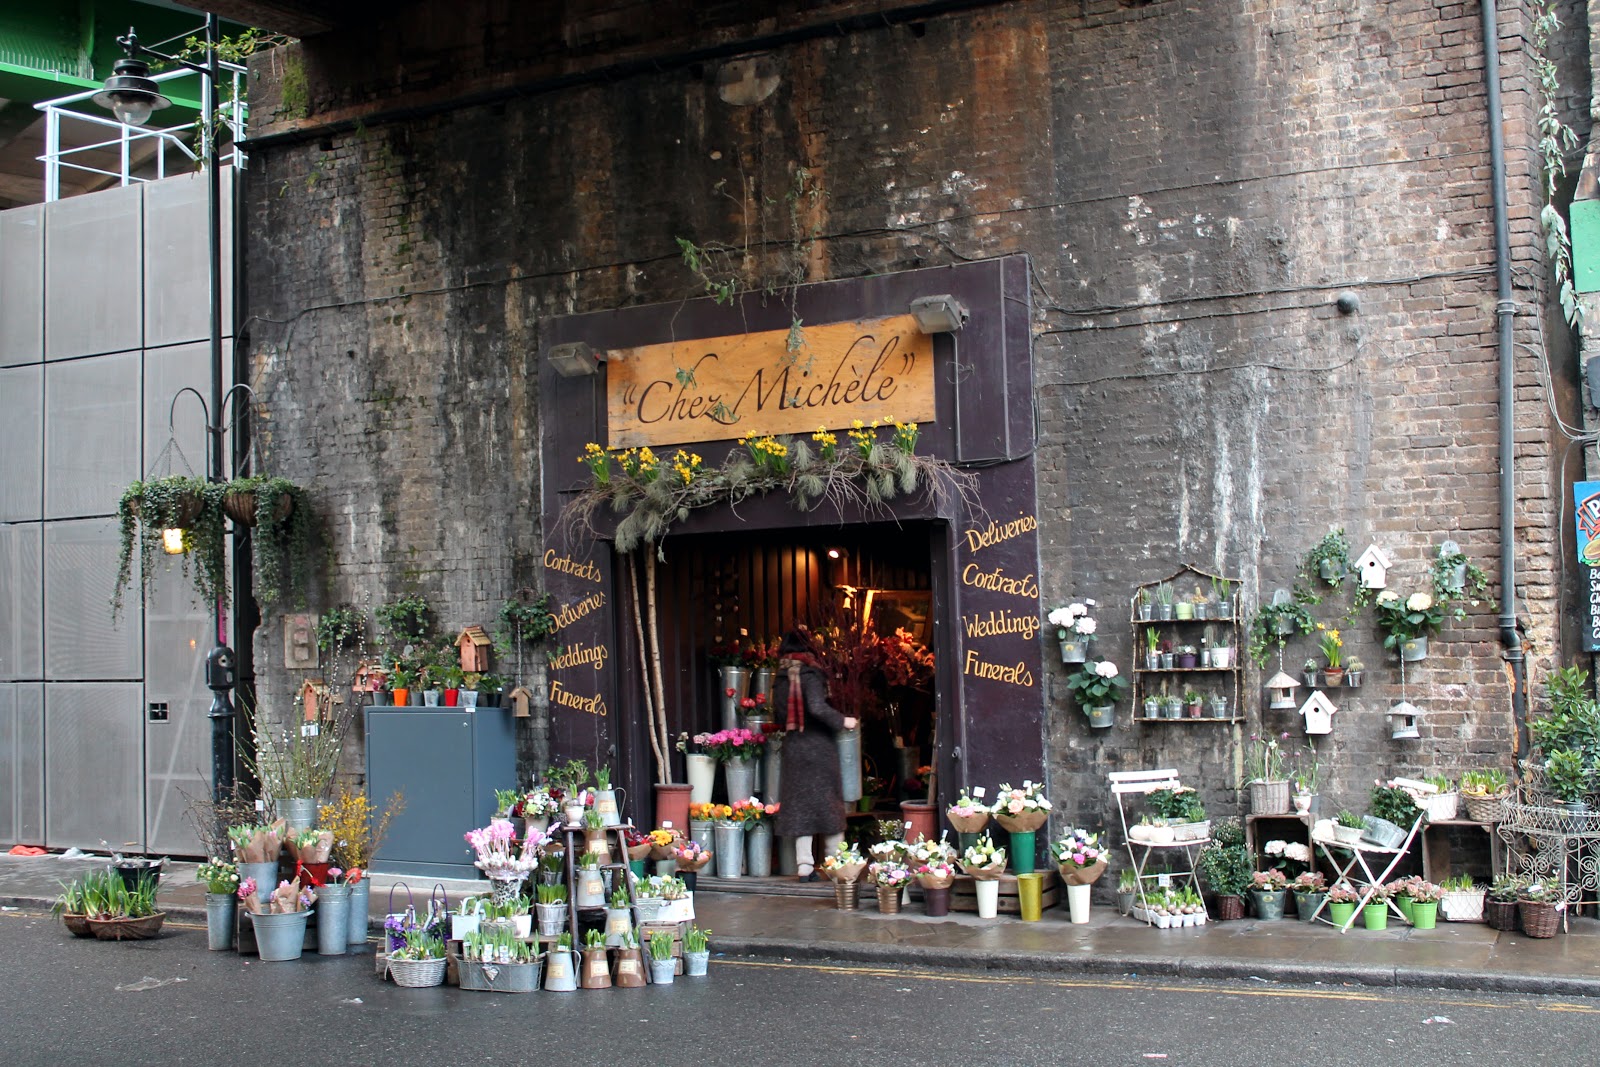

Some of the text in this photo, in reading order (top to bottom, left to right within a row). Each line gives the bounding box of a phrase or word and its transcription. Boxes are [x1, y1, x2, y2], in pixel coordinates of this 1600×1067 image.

[965, 511, 1037, 553] Deliveries
[544, 548, 602, 583] Contracts
[962, 563, 1039, 599] Contracts
[962, 609, 1041, 640] Weddings
[964, 650, 1033, 687] Funerals
[550, 680, 607, 716] Funerals
